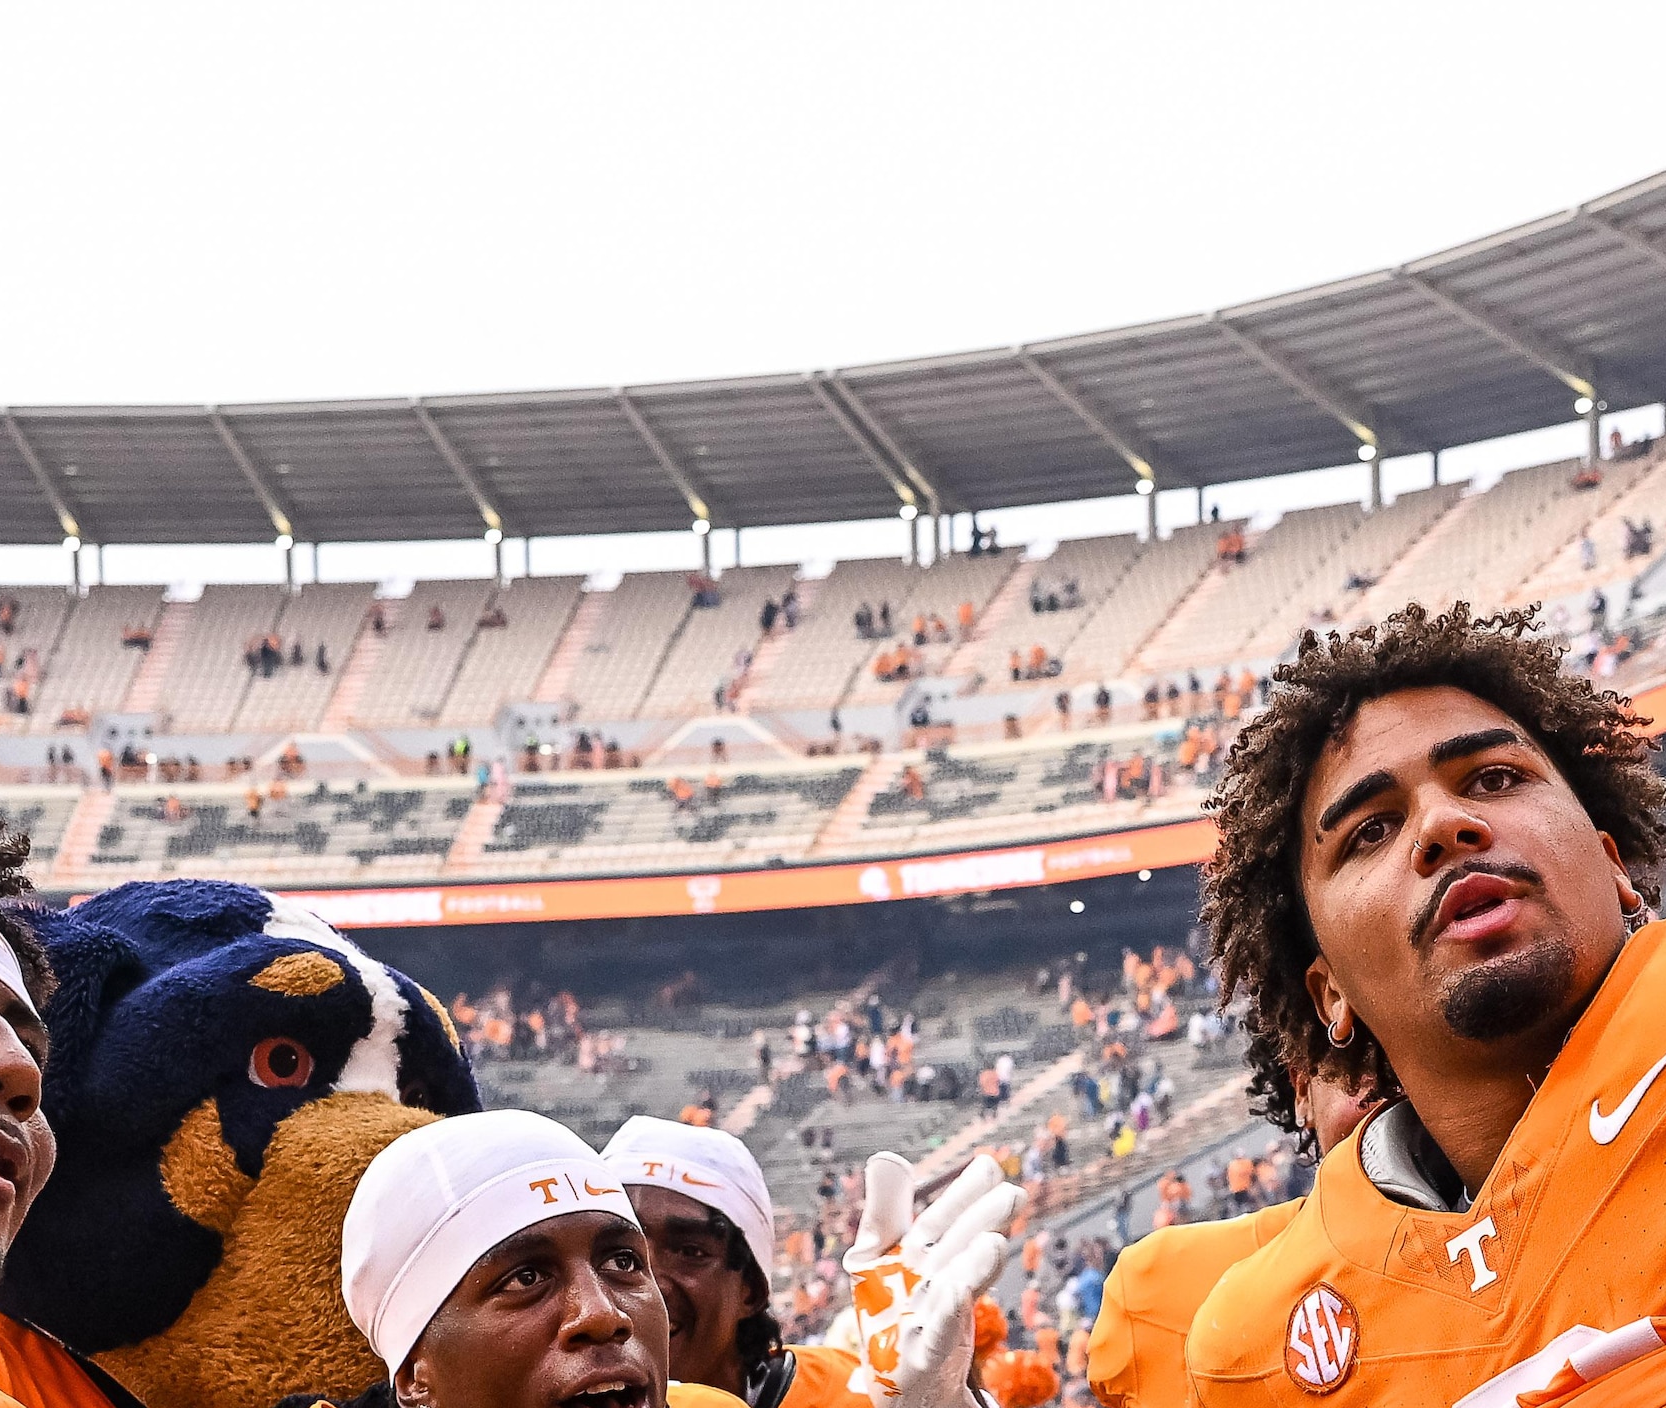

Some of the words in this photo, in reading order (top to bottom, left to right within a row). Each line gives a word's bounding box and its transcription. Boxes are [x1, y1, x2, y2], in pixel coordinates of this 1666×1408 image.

[529, 1178, 558, 1204] T
[643, 1162, 663, 1176] T
[1444, 1216, 1499, 1294] T
[1290, 1284, 1357, 1393] SEC
